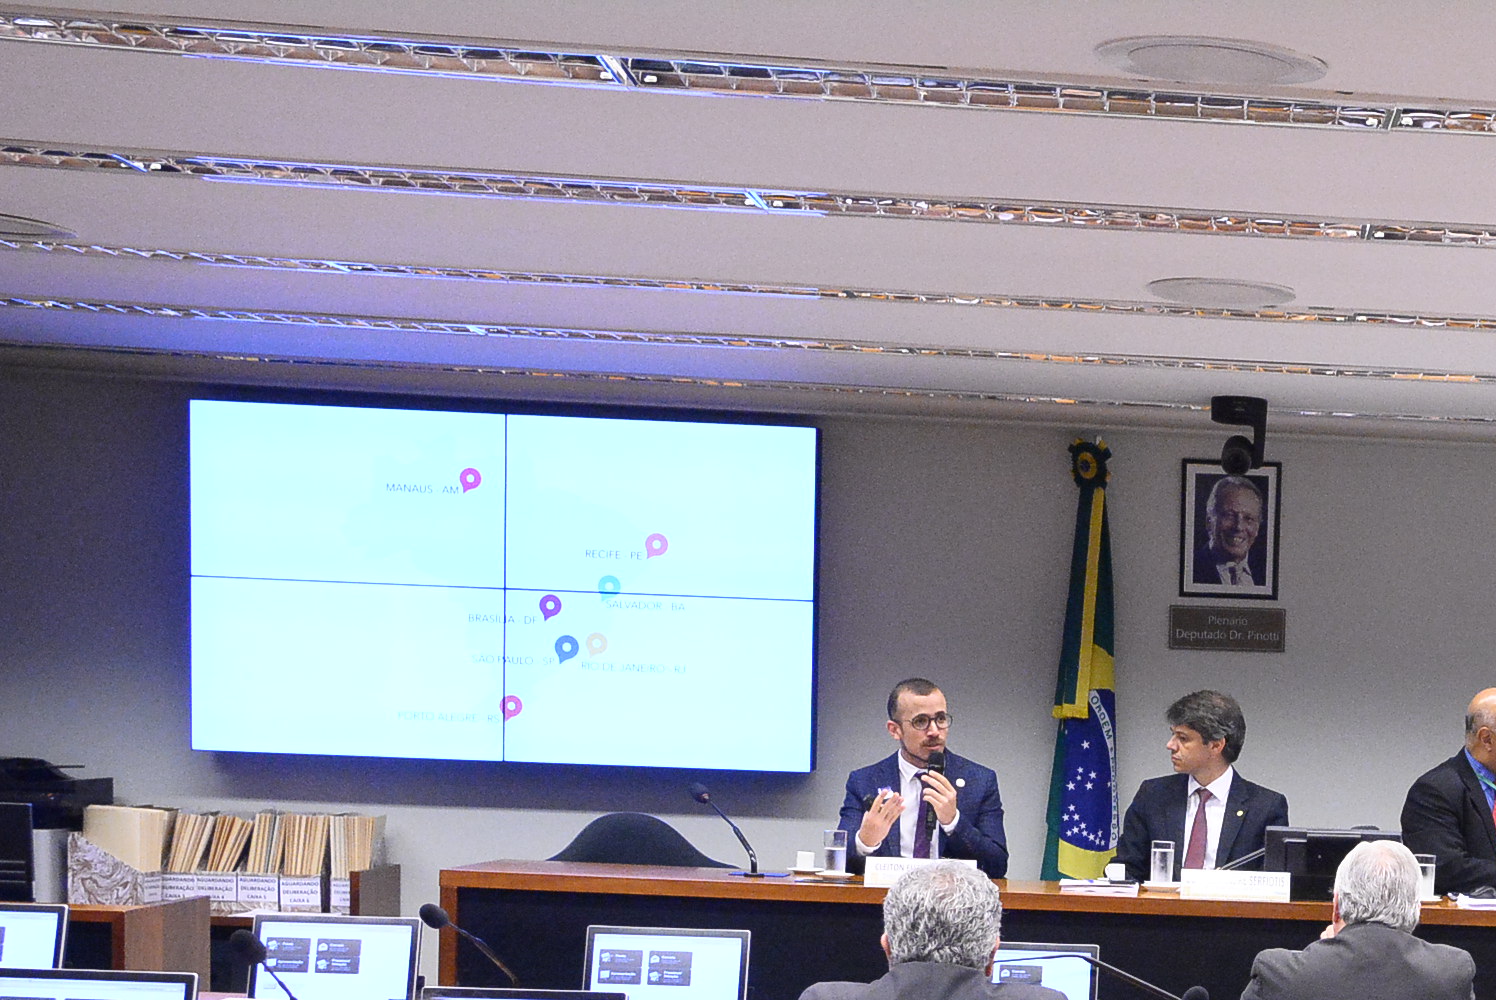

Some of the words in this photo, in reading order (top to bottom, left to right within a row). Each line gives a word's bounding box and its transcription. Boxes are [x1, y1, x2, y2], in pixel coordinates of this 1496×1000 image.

[386, 483, 433, 494] MANAUS
[442, 485, 459, 495] AM
[585, 549, 621, 560] RECIFE
[630, 550, 643, 560] PE
[605, 599, 663, 610] SALVADOR
[467, 612, 516, 625] BRASÍLA
[1176, 628, 1226, 641] Deputado
[1229, 630, 1245, 640] Dr.
